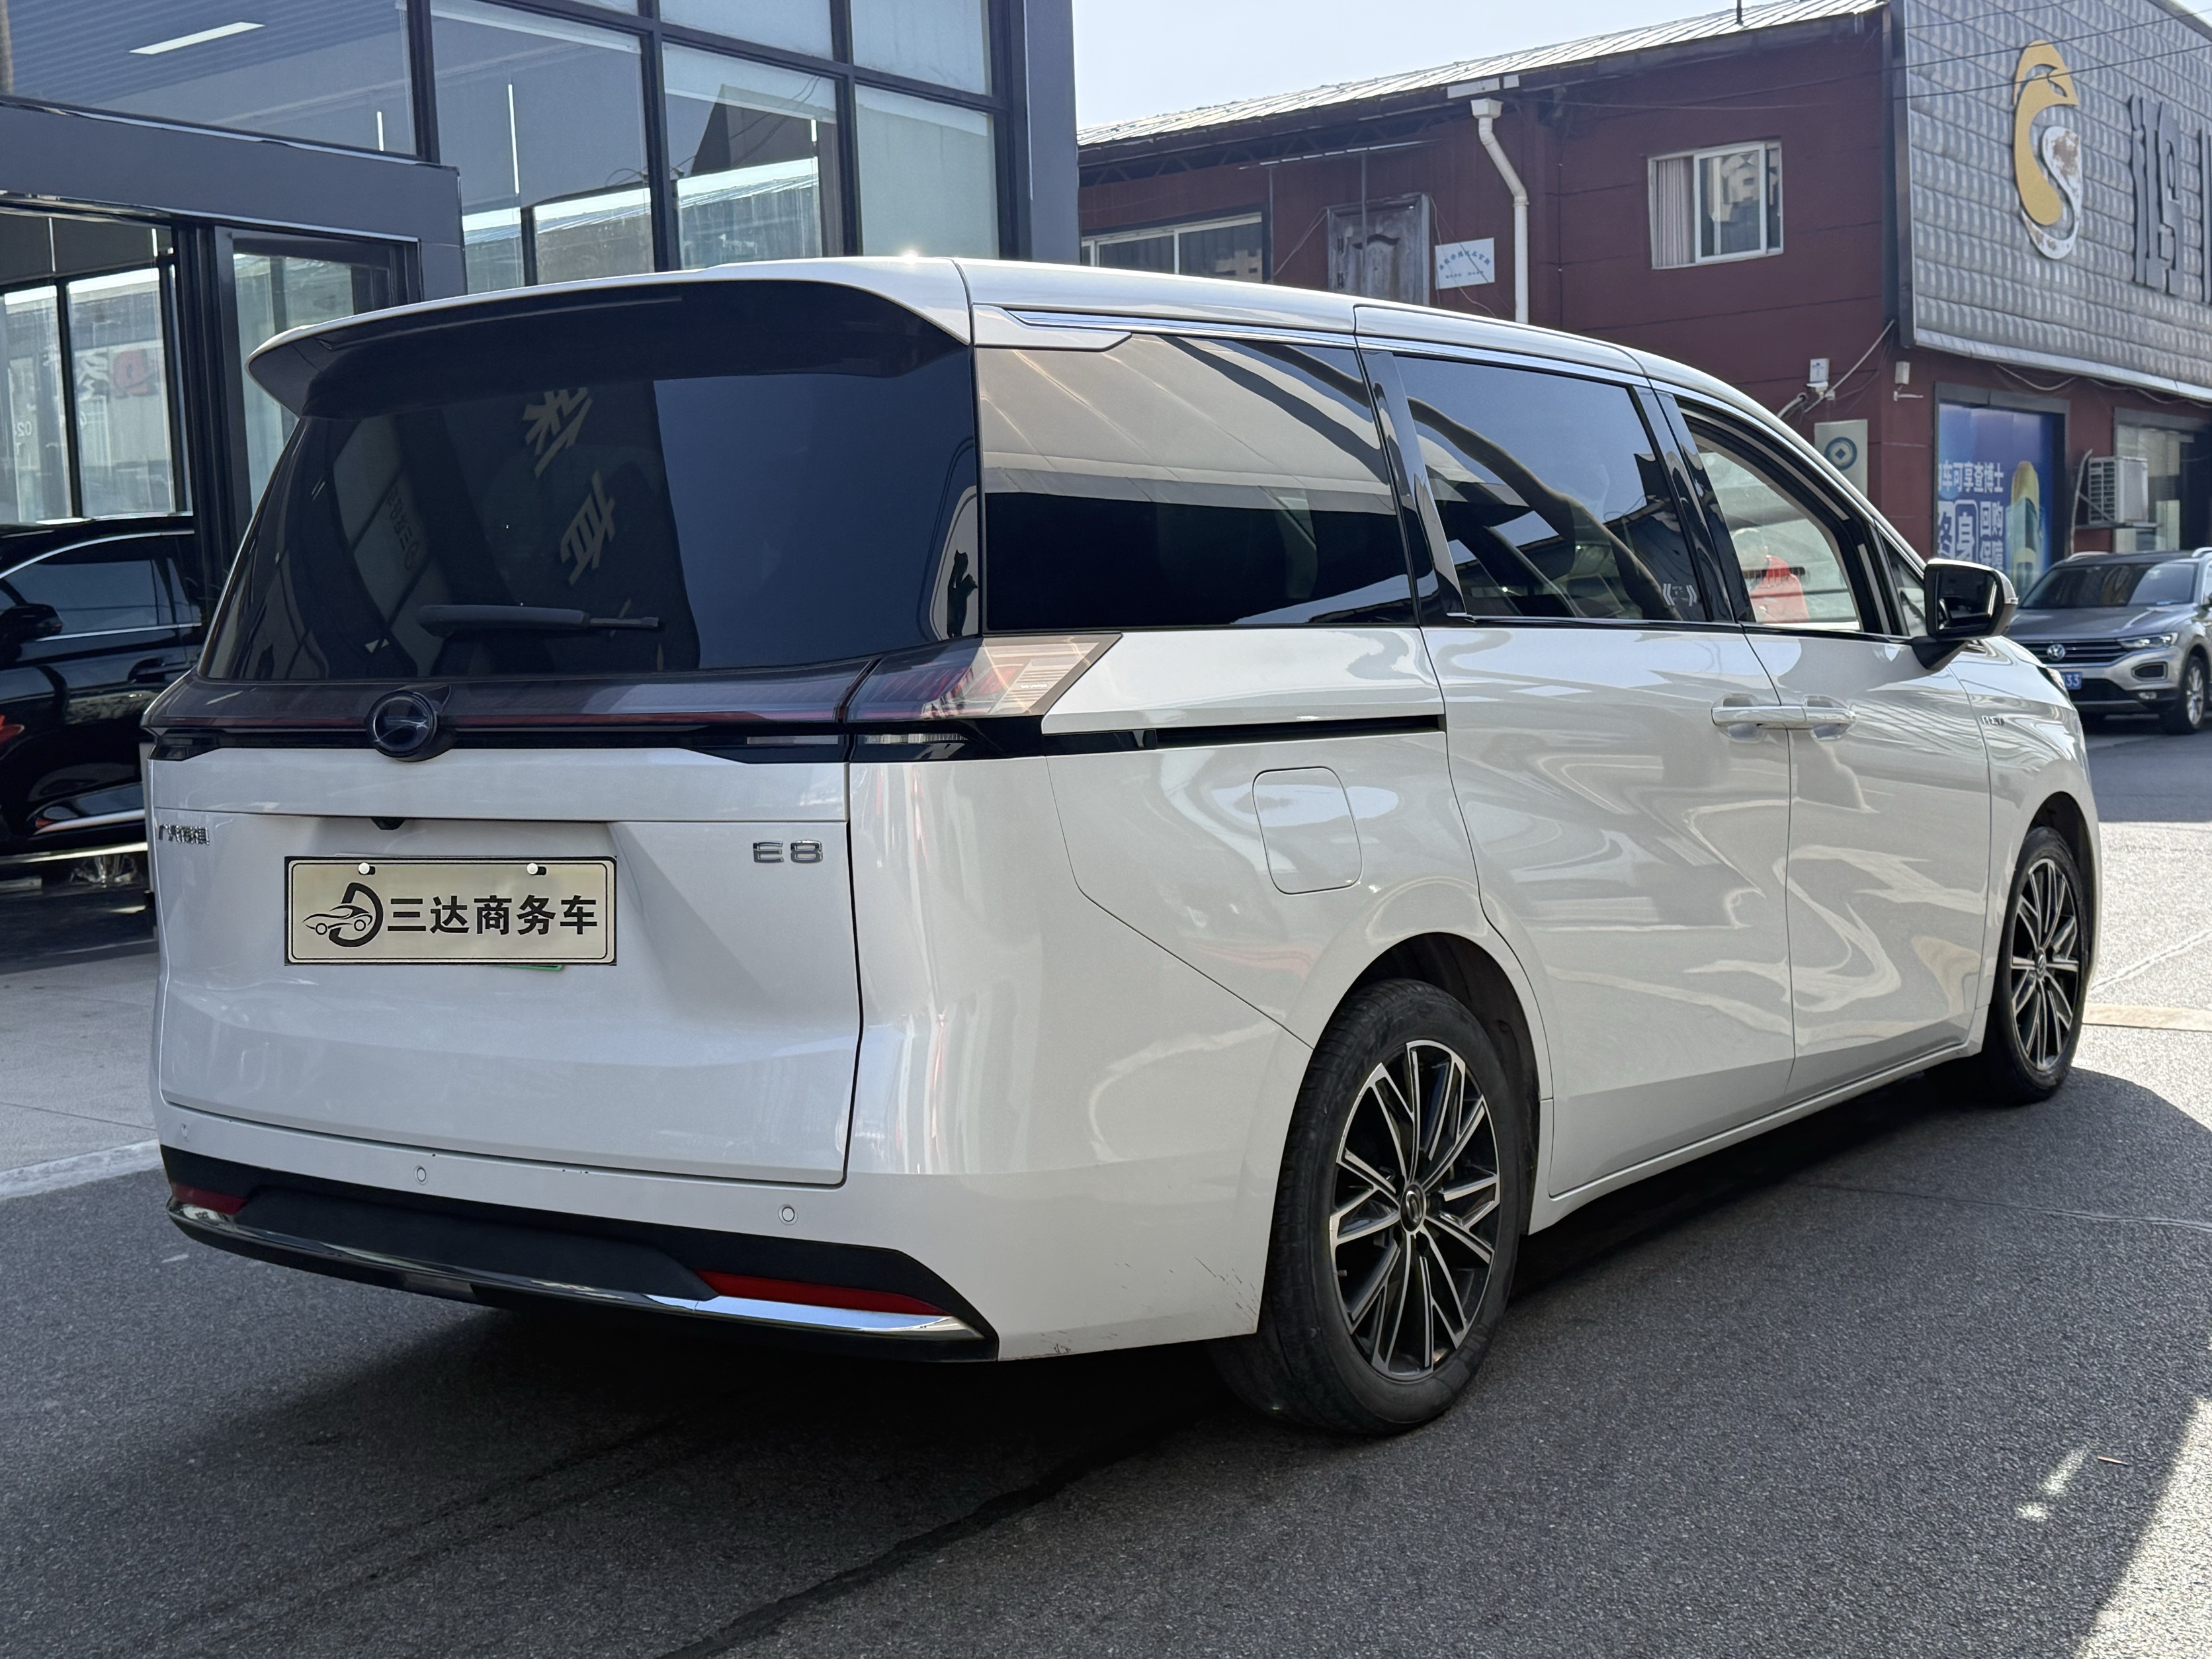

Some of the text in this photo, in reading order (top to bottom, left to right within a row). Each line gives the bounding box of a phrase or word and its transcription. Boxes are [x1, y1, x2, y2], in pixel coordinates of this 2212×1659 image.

[753, 839, 823, 863] E8
[387, 895, 598, 935] 三达商务车
